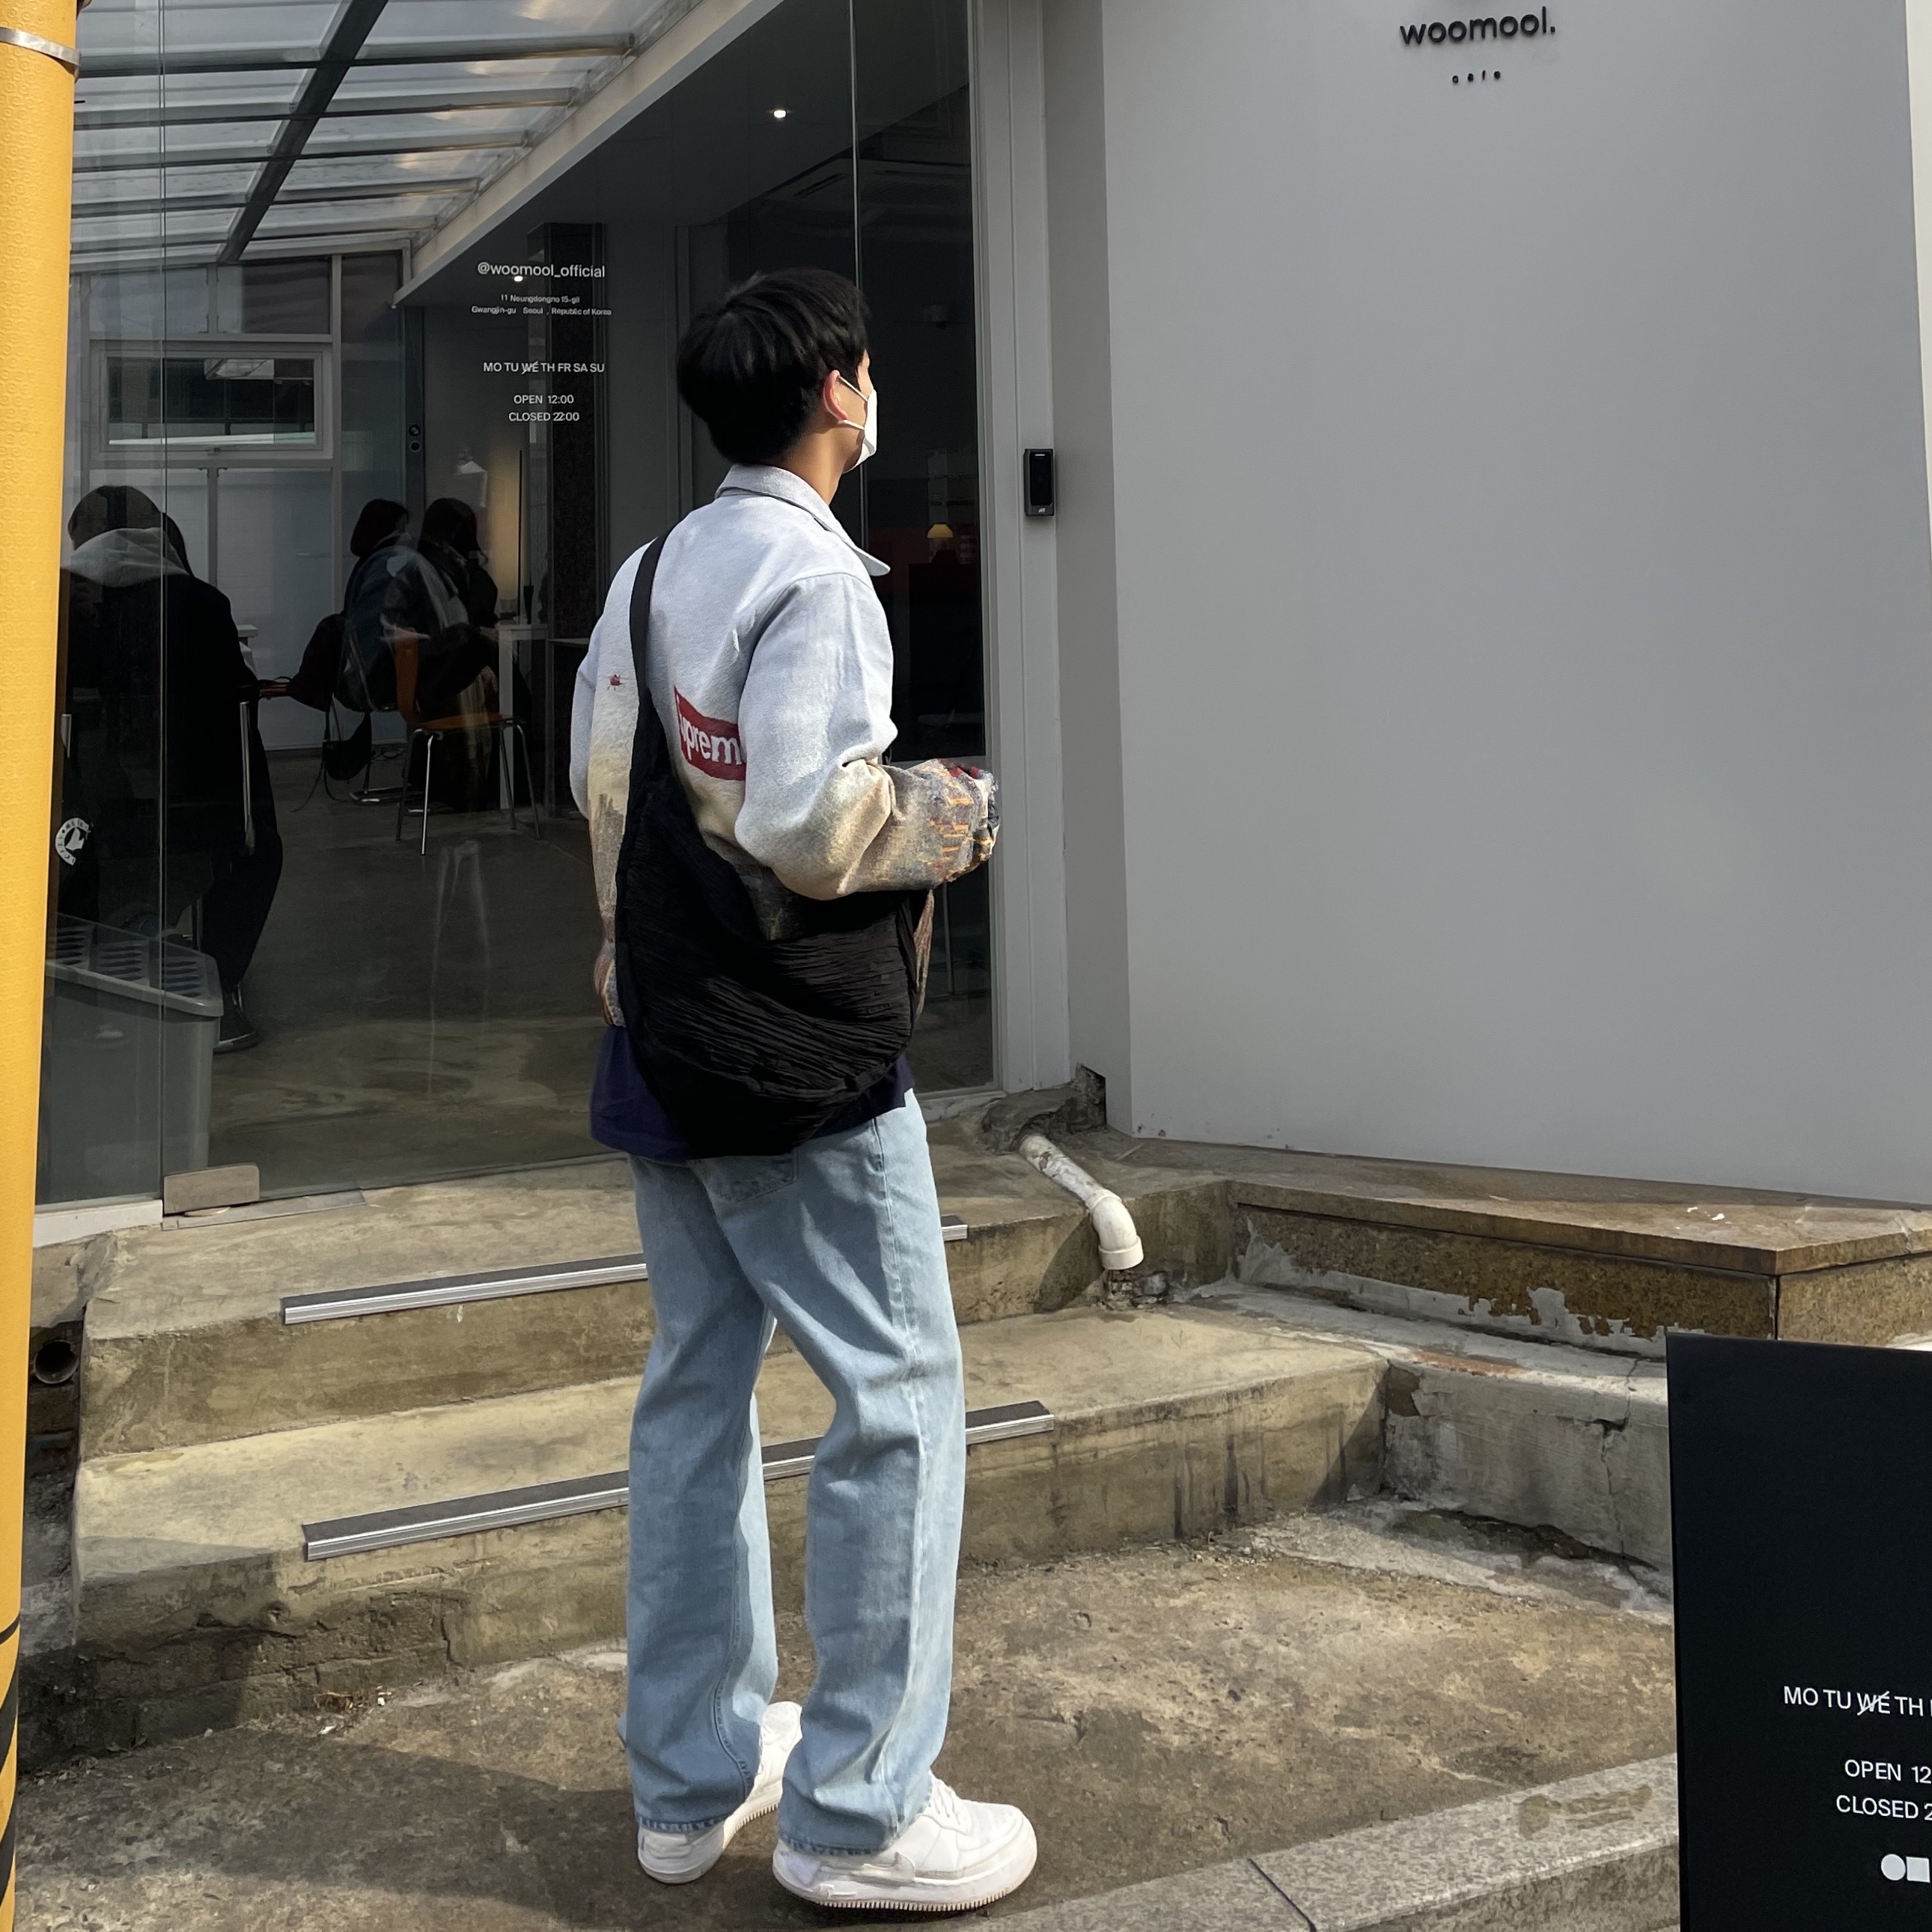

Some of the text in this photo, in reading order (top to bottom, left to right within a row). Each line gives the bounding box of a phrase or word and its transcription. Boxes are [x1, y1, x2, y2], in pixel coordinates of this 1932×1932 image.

[1399, 6, 1555, 45] woomool.
[478, 262, 605, 278] @woomool_official
[551, 307, 582, 316] Republic
[483, 362, 502, 372] MO
[504, 362, 519, 372] TU
[540, 362, 555, 372] TH
[557, 362, 571, 373] FR
[573, 362, 588, 373] SA
[589, 362, 605, 373] SU
[514, 394, 574, 404] OPEN 12:00
[508, 412, 551, 421] CLOSED
[1784, 1686, 1819, 1707] MO
[1822, 1689, 1852, 1710] TU
[1894, 1695, 1924, 1717] TH
[1844, 1759, 1901, 1782] OPEN
[1836, 1794, 1919, 1820] CLOSED
